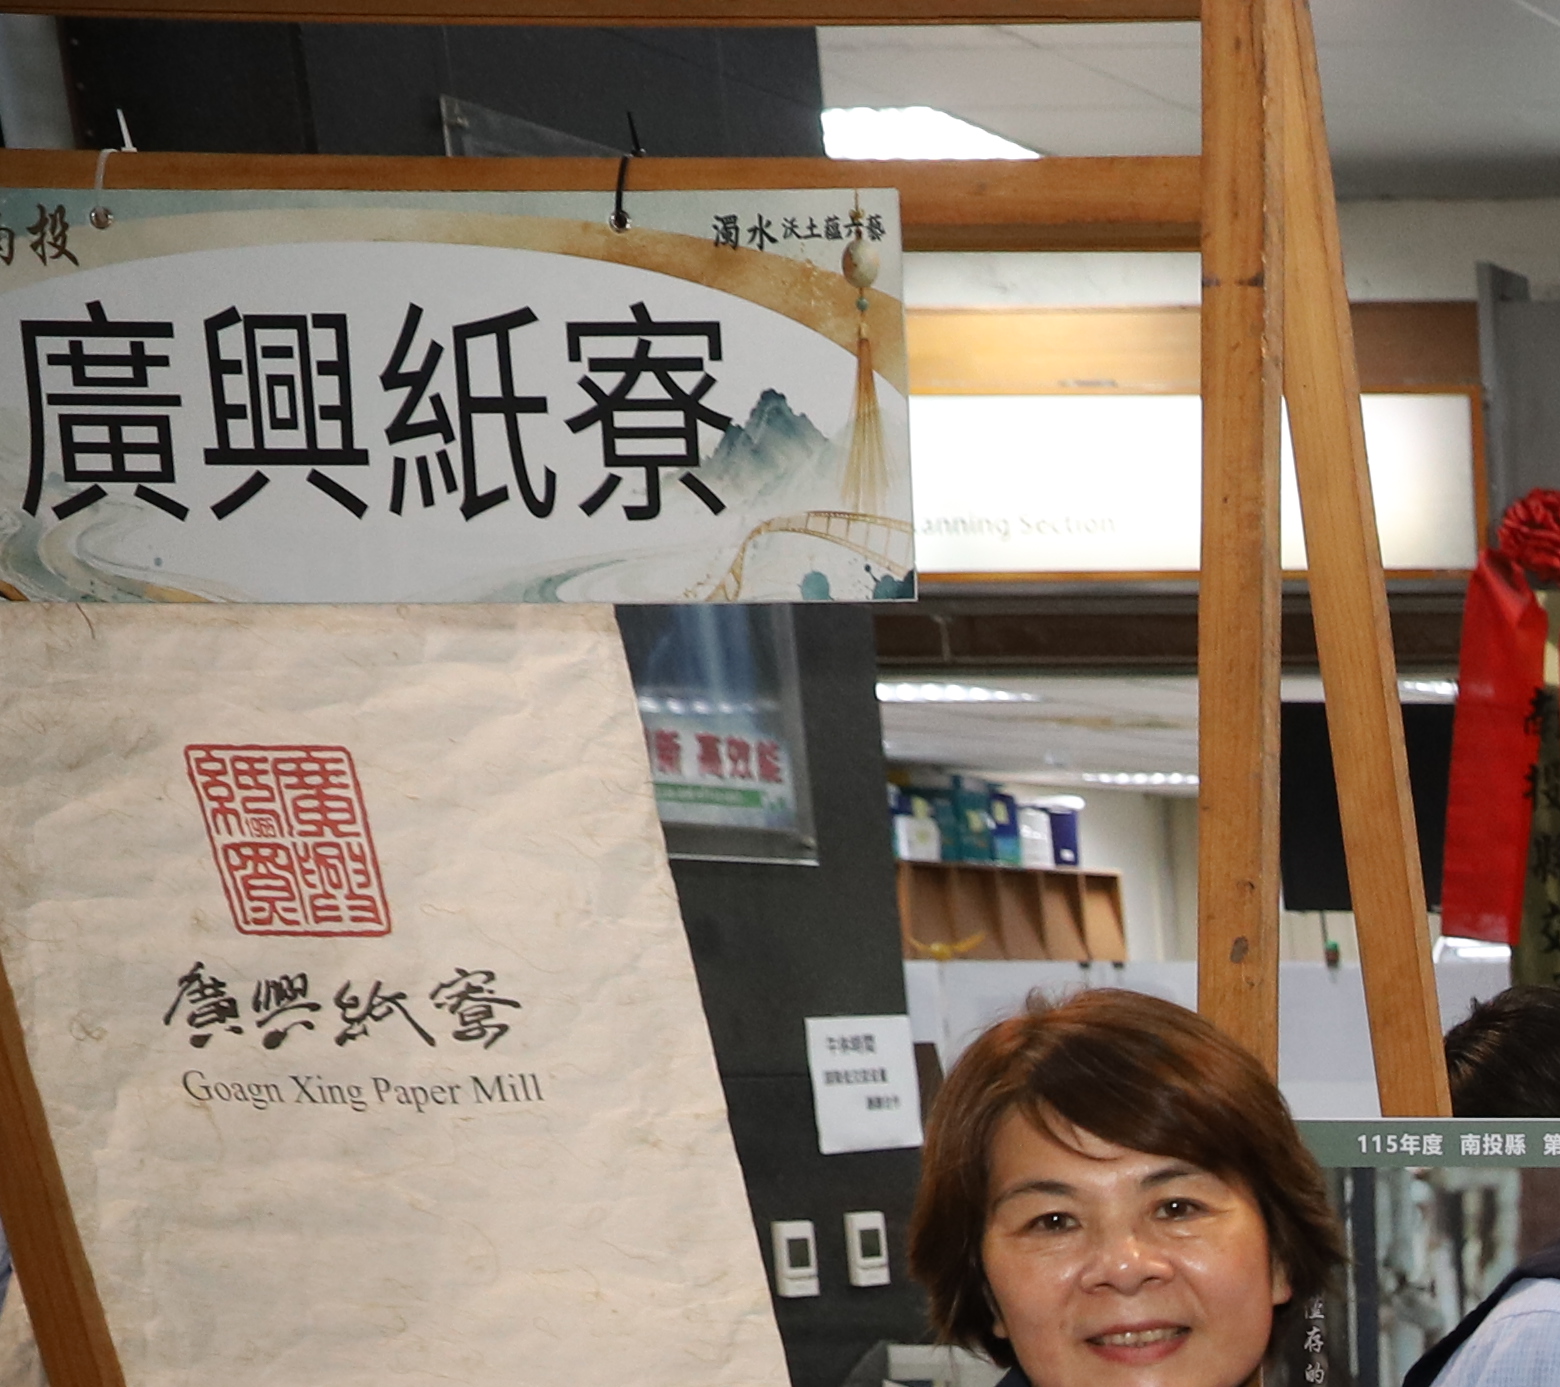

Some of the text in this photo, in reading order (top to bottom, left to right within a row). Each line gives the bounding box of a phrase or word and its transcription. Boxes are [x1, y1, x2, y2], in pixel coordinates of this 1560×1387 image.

[21, 301, 733, 521] 廣興紙寮
[1019, 514, 1116, 536] Section
[182, 1070, 545, 1113] Goagn Xing Paper Mill
[1357, 1134, 1444, 1156] 115年度
[1460, 1133, 1527, 1156] 南投縣
